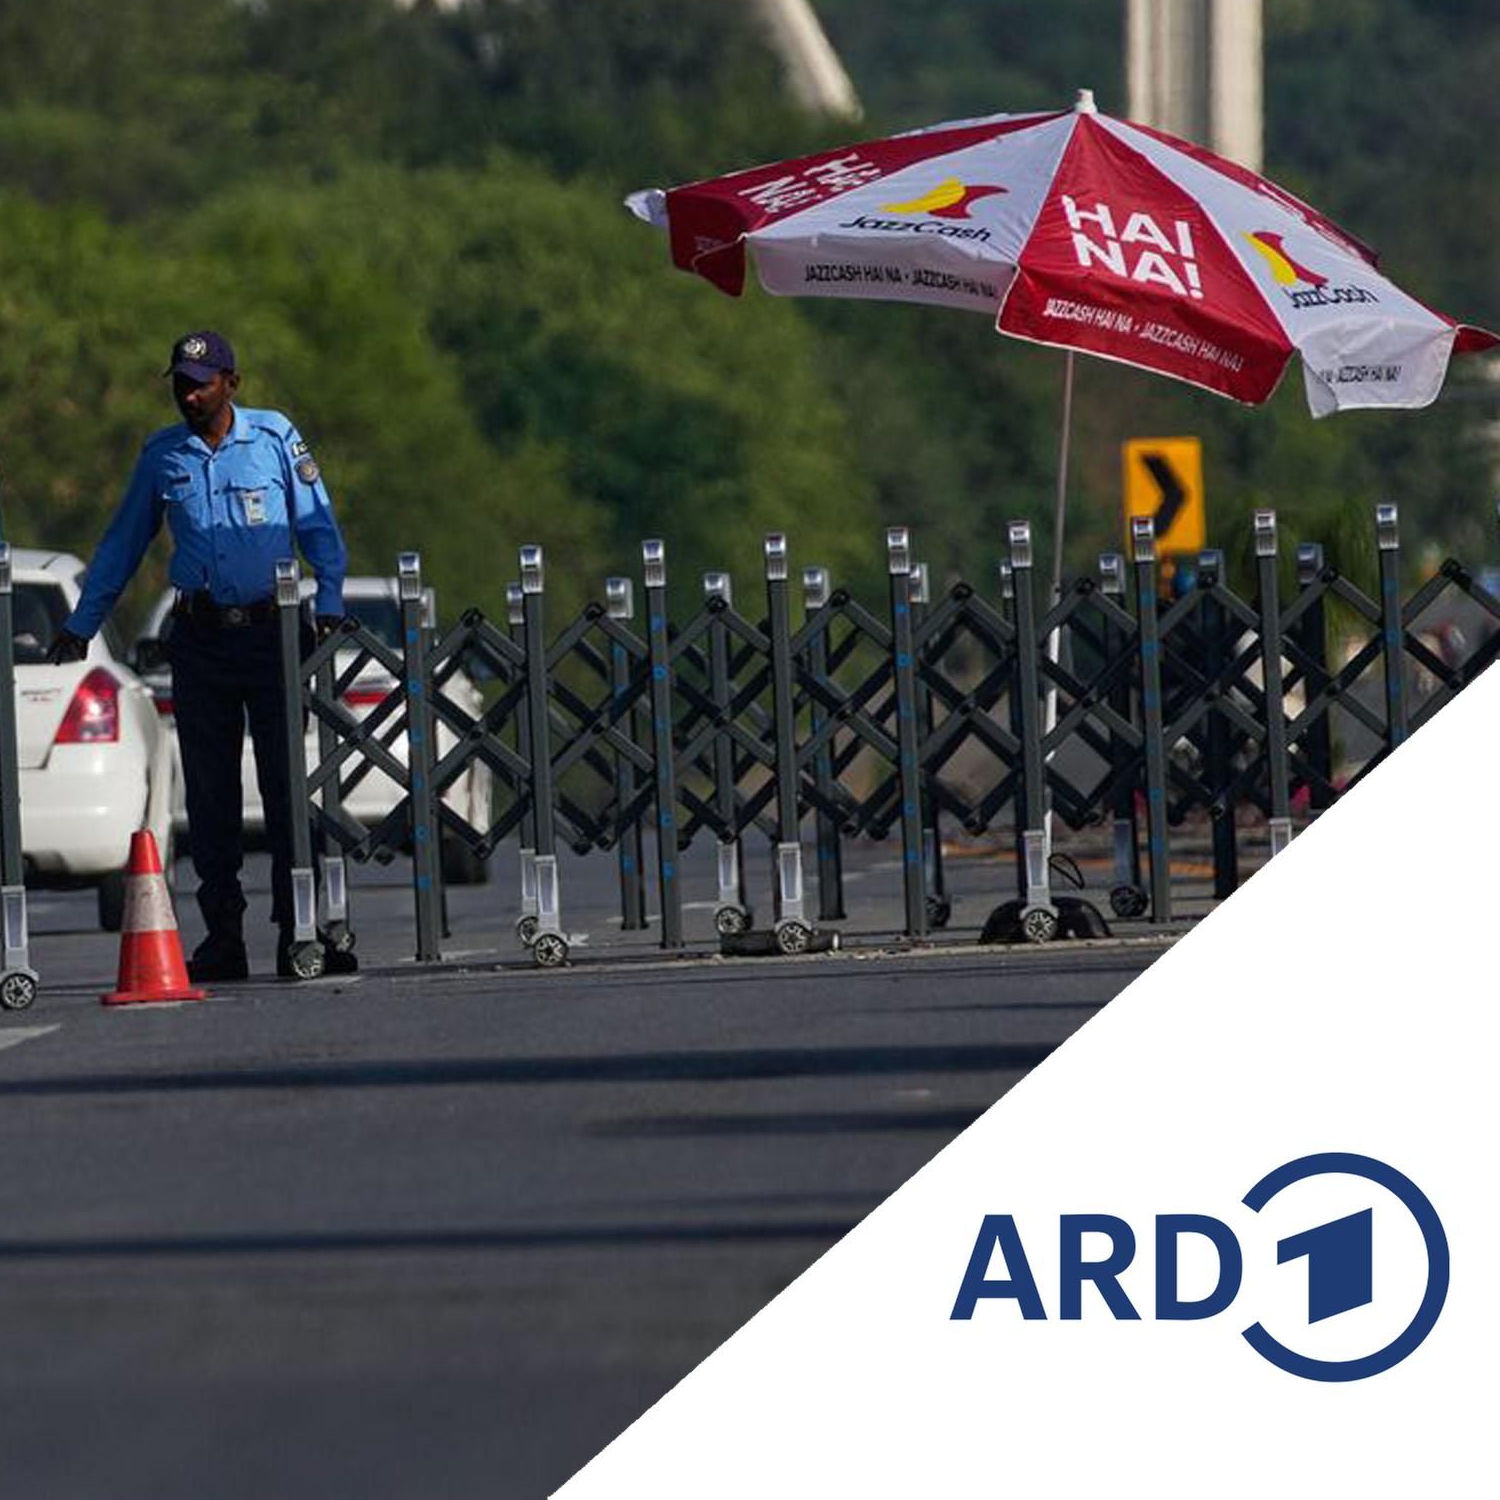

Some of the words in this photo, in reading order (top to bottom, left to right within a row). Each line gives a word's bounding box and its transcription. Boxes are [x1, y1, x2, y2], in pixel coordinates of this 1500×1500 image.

[839, 215, 992, 242] JazzCash
[1061, 195, 1195, 258] HAI
[805, 264, 862, 283] JAZZCASH
[863, 265, 884, 283] HAI
[885, 265, 902, 283] NA
[1072, 231, 1204, 299] NA!
[1281, 284, 1380, 309] JazzCash
[1043, 298, 1097, 324] JAZZCASH
[1094, 307, 1117, 330] HAI
[1114, 313, 1134, 334] NA
[1139, 322, 1200, 356] JAZZCASH
[1197, 340, 1221, 362] HAI
